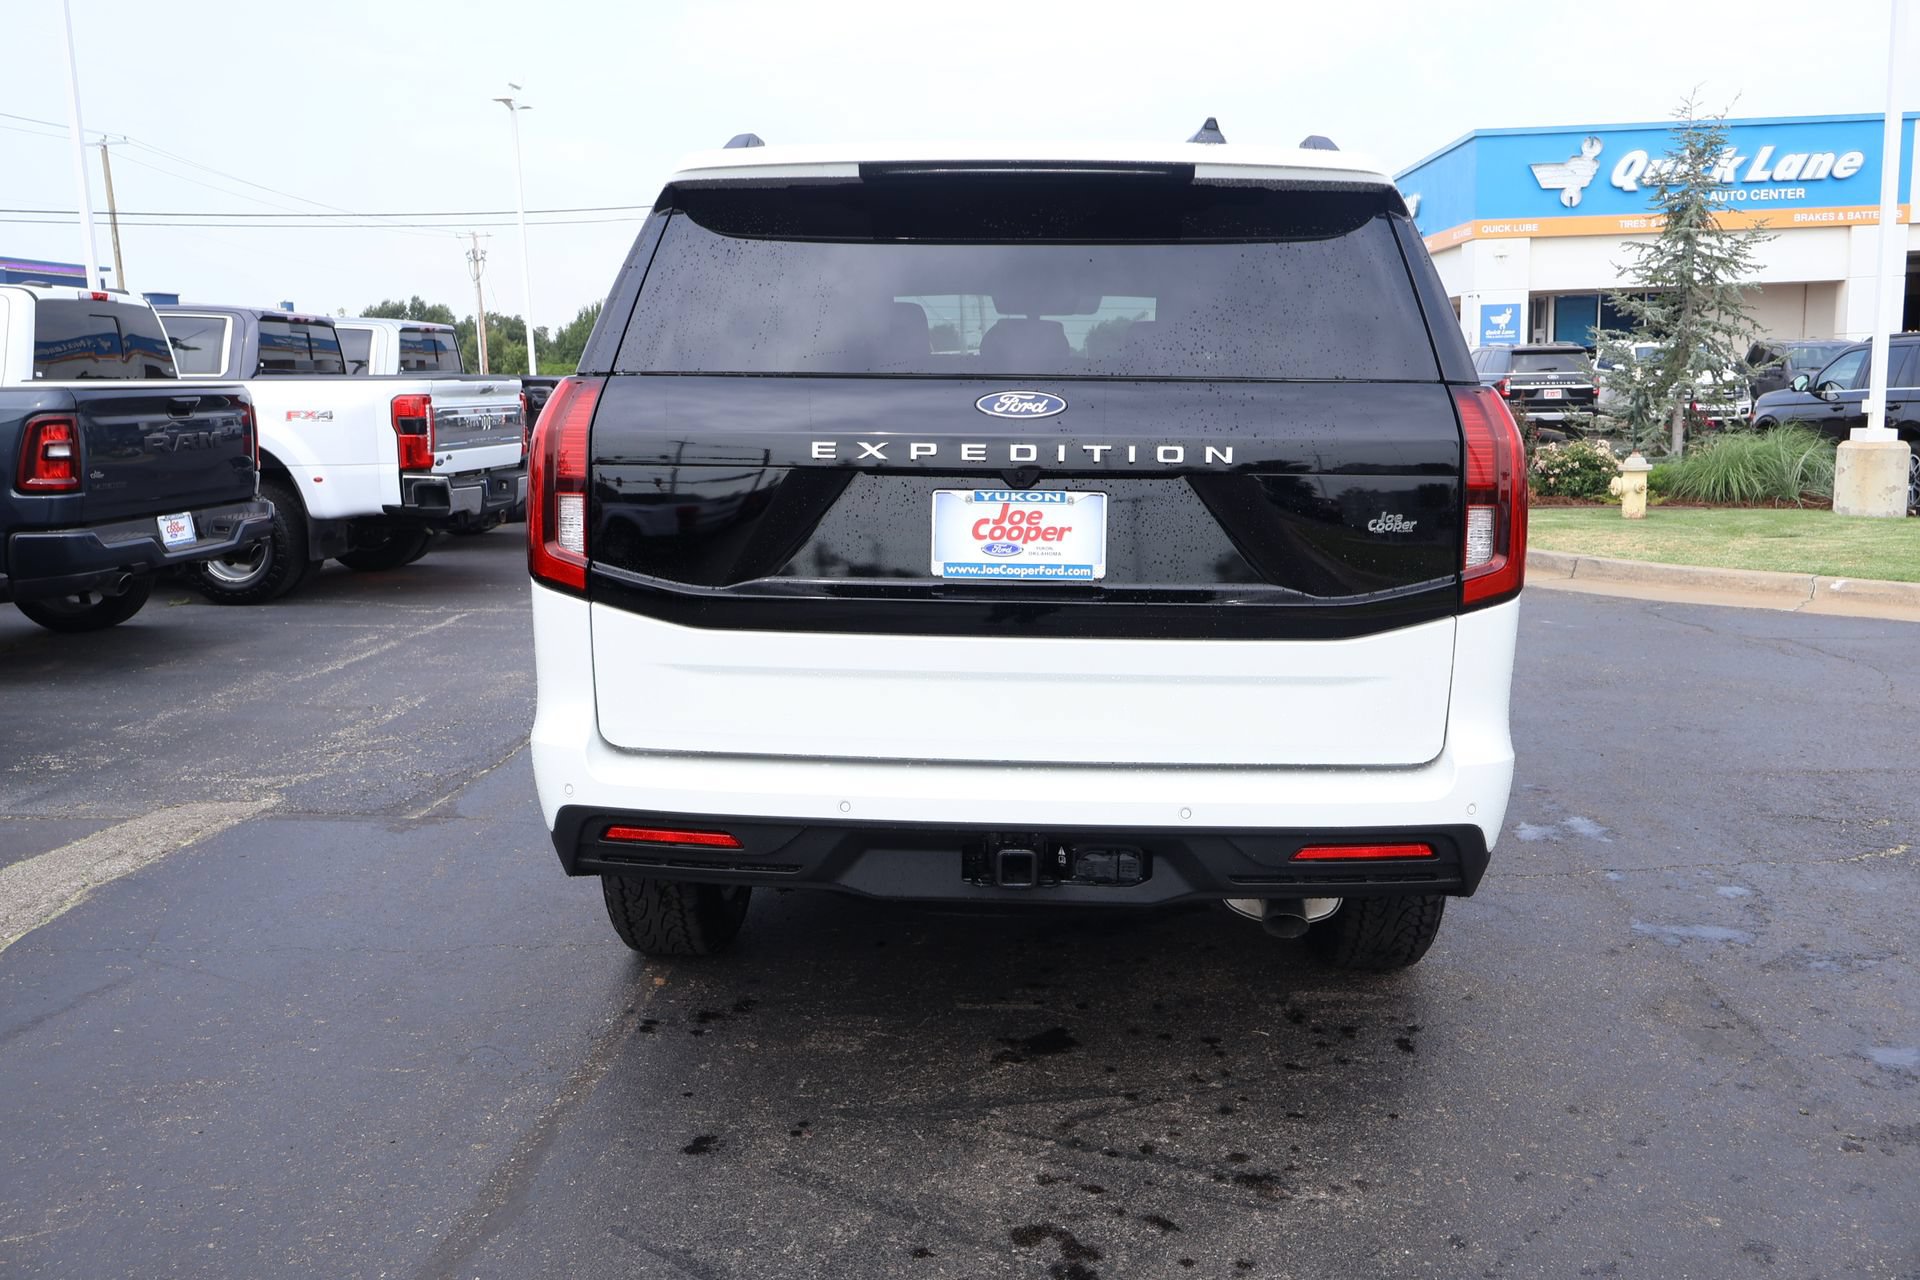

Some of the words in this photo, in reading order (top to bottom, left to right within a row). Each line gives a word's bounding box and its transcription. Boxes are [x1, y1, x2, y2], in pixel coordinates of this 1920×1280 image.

[1743, 145, 1864, 182] Lane
[1709, 190, 1747, 202] AUTO
[1750, 187, 1805, 201] CENTER
[1794, 213, 1834, 222] BRAKES
[1837, 212, 1844, 220] &
[1847, 209, 1903, 220] BATTES
[1481, 224, 1511, 233] QUICK
[1513, 223, 1539, 232] LUBE
[1619, 219, 1646, 229] TIRES
[993, 394, 1049, 413] Ford
[286, 410, 333, 421] FX4
[144, 431, 221, 453] RAM
[811, 441, 1234, 464] EXPEDITION
[980, 491, 1061, 502] YUKON
[992, 502, 1043, 526] Joe
[1378, 511, 1403, 523] Joe
[971, 518, 1072, 544] Cooper
[1368, 519, 1418, 532] Cooper
[946, 565, 1091, 577] www.JoeCooperFord.com
